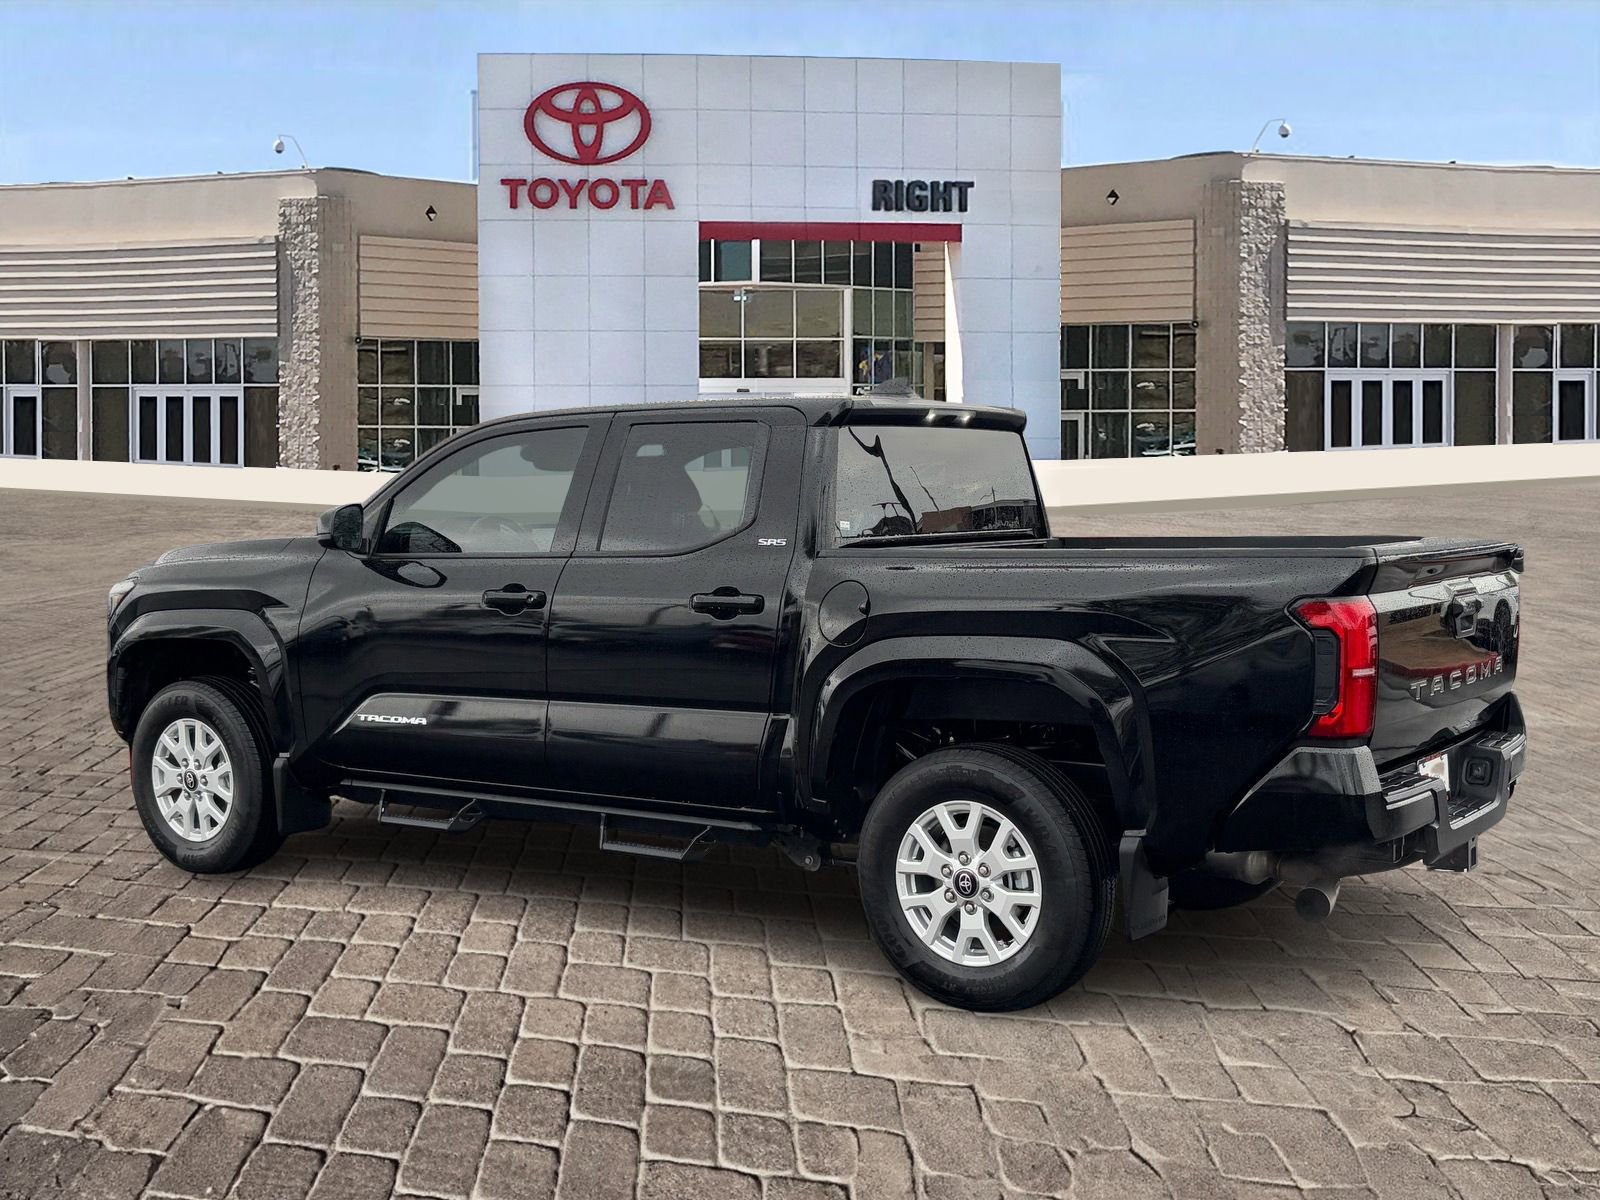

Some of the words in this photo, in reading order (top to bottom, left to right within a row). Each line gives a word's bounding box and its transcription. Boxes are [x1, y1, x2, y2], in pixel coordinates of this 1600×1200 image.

[501, 178, 675, 210] TOYOTA
[872, 180, 974, 212] RIGHT
[758, 538, 787, 546] SR5
[1410, 655, 1503, 700] TACOMA
[357, 713, 427, 725] TACOMA
